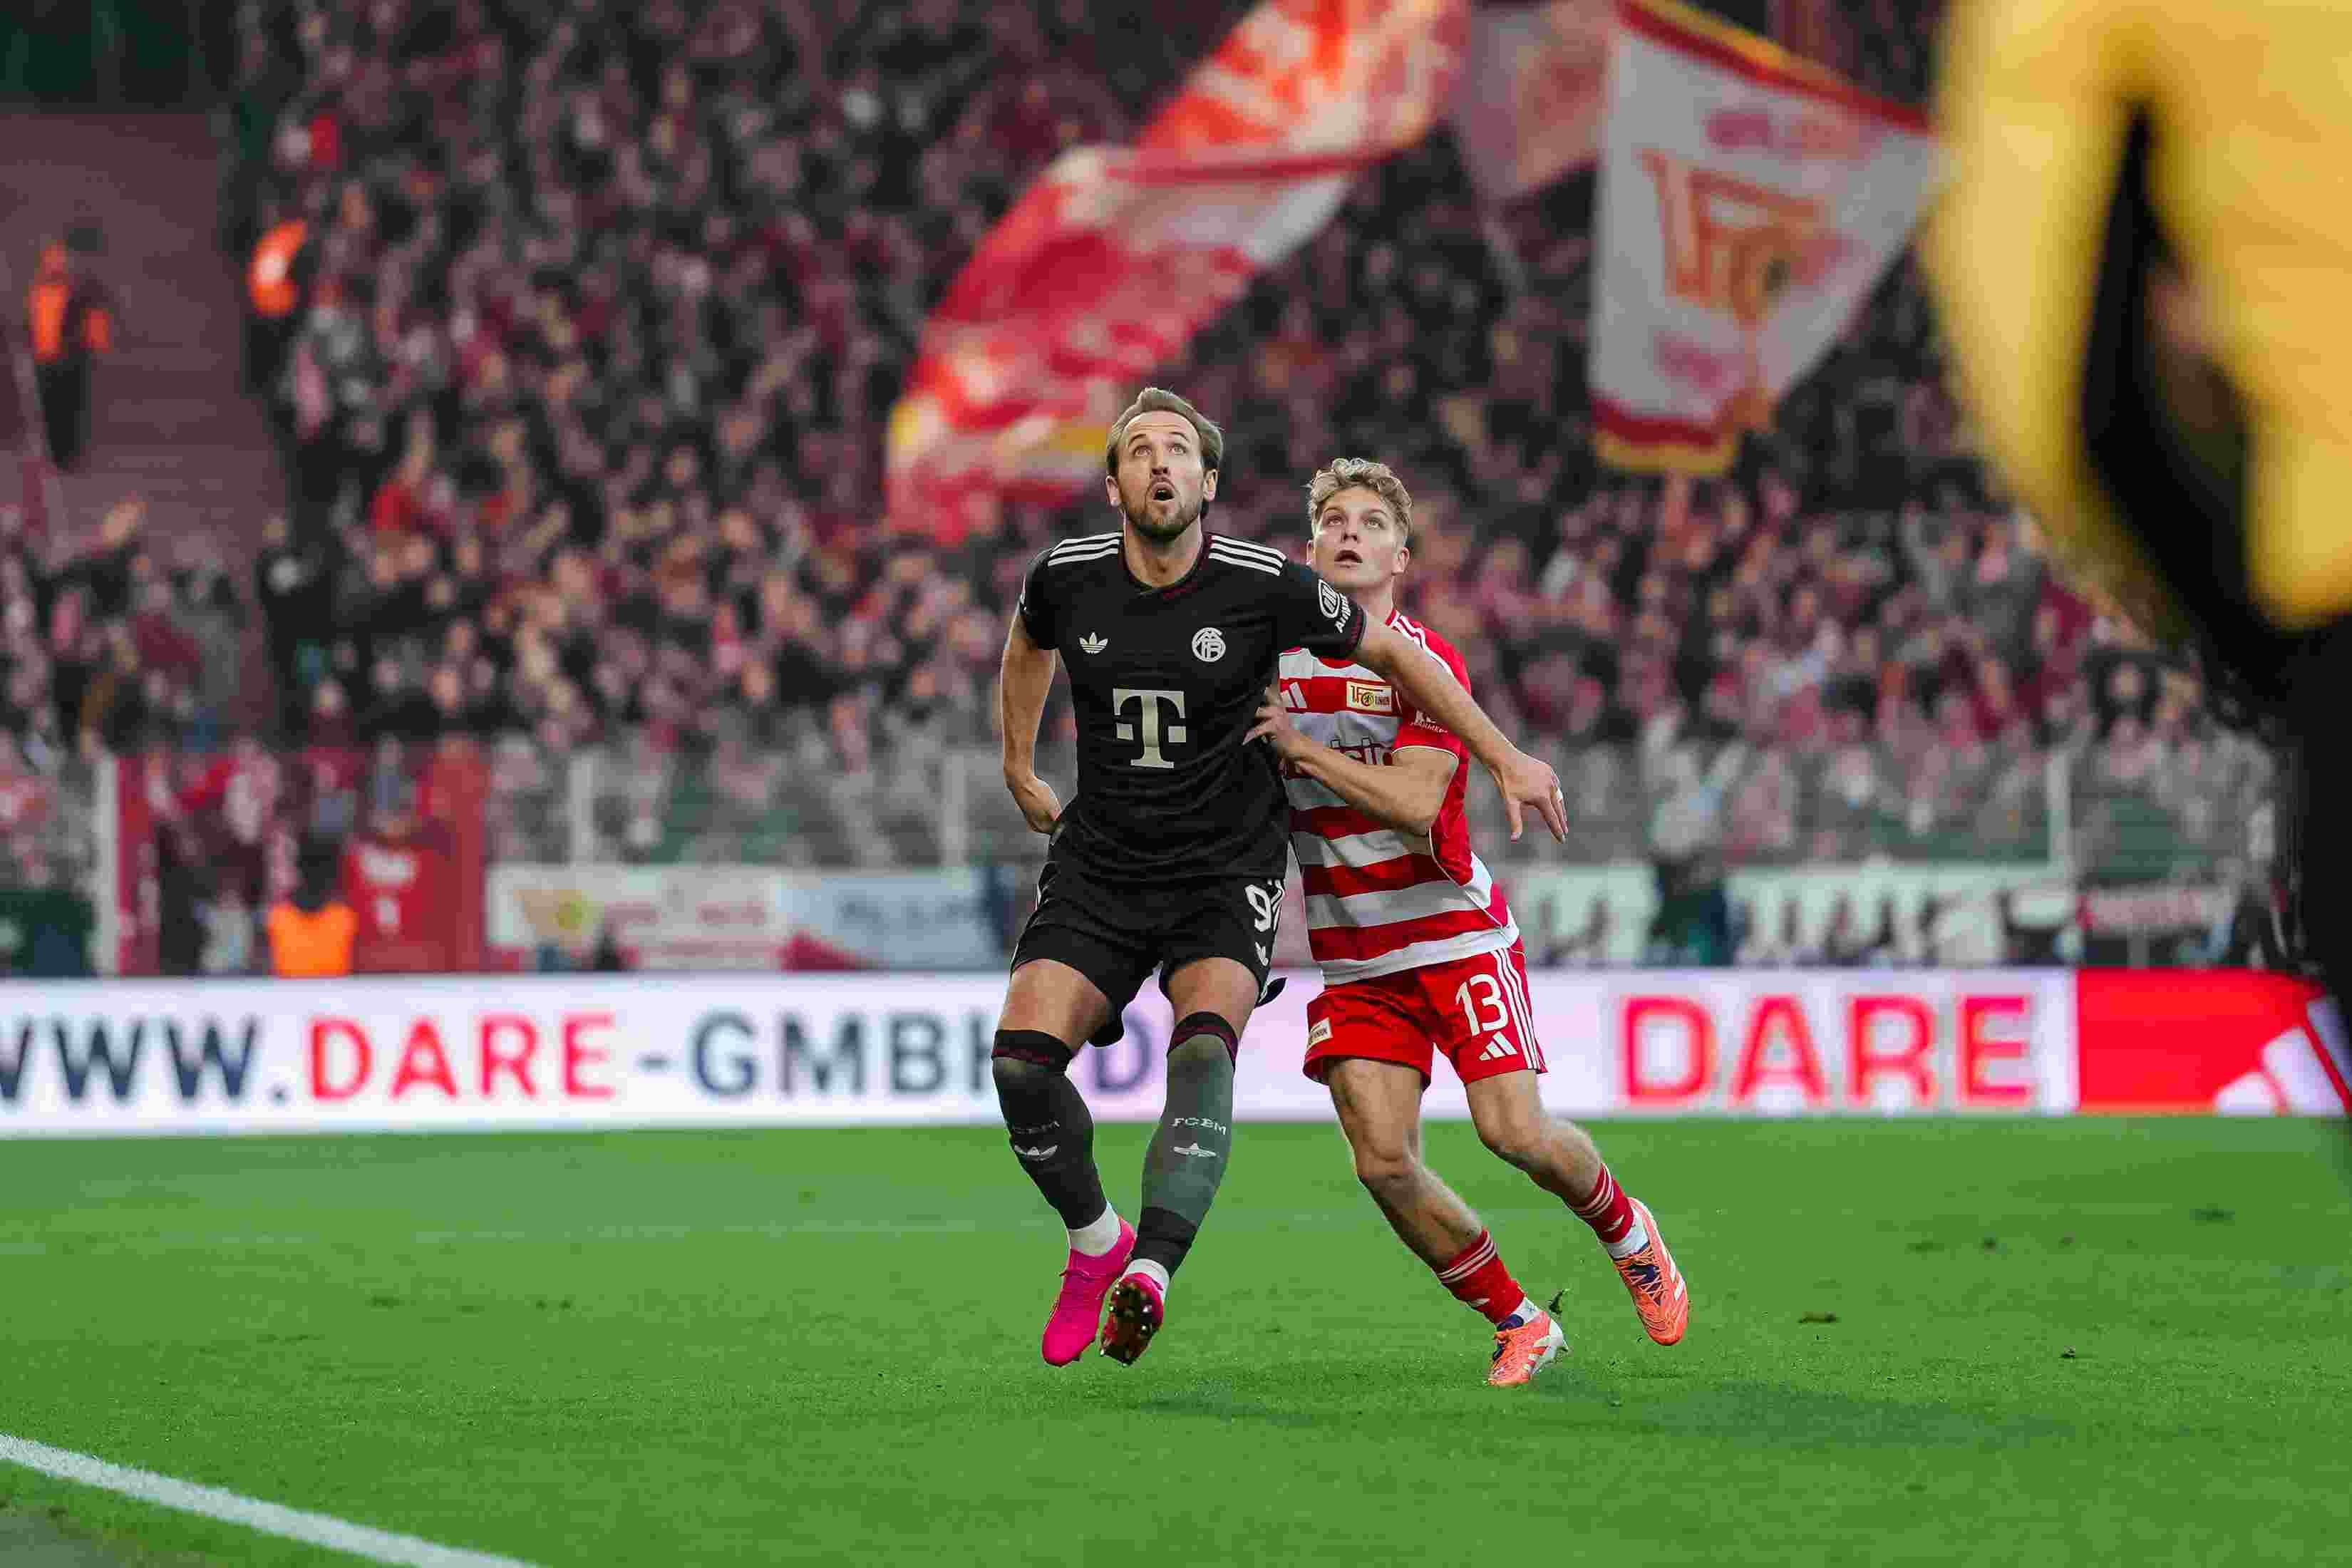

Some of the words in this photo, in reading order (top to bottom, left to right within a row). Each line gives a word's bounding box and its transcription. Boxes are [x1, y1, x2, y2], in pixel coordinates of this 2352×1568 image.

[1244, 884, 1272, 932] 9
[1455, 974, 1508, 1036] 13
[1621, 995, 2036, 1103] DARE
